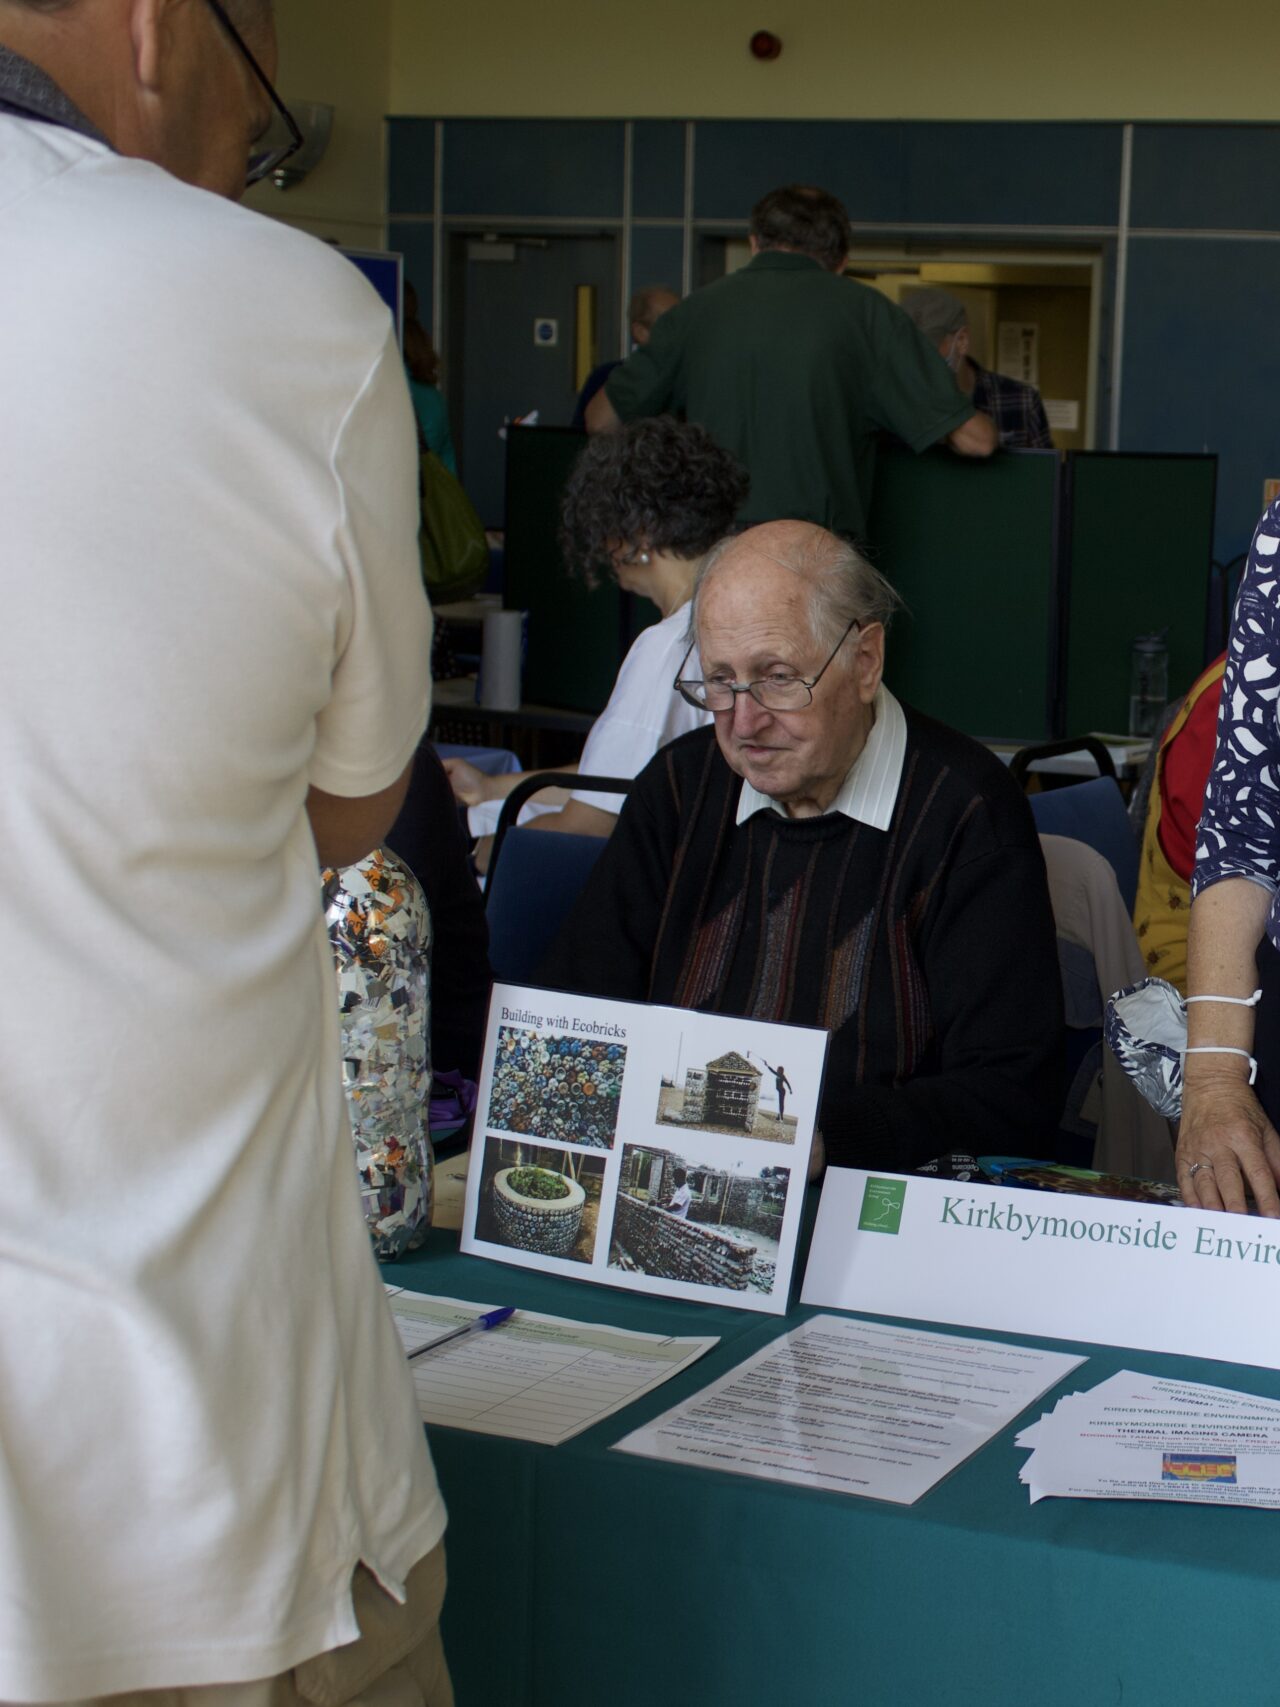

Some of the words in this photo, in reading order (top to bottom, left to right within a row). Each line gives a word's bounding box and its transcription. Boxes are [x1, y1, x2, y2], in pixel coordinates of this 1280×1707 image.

[501, 1006, 543, 1029] Building
[546, 1014, 569, 1030] with
[572, 1017, 627, 1038] Ecobricks
[939, 1195, 1178, 1252] Kirkbymoorside
